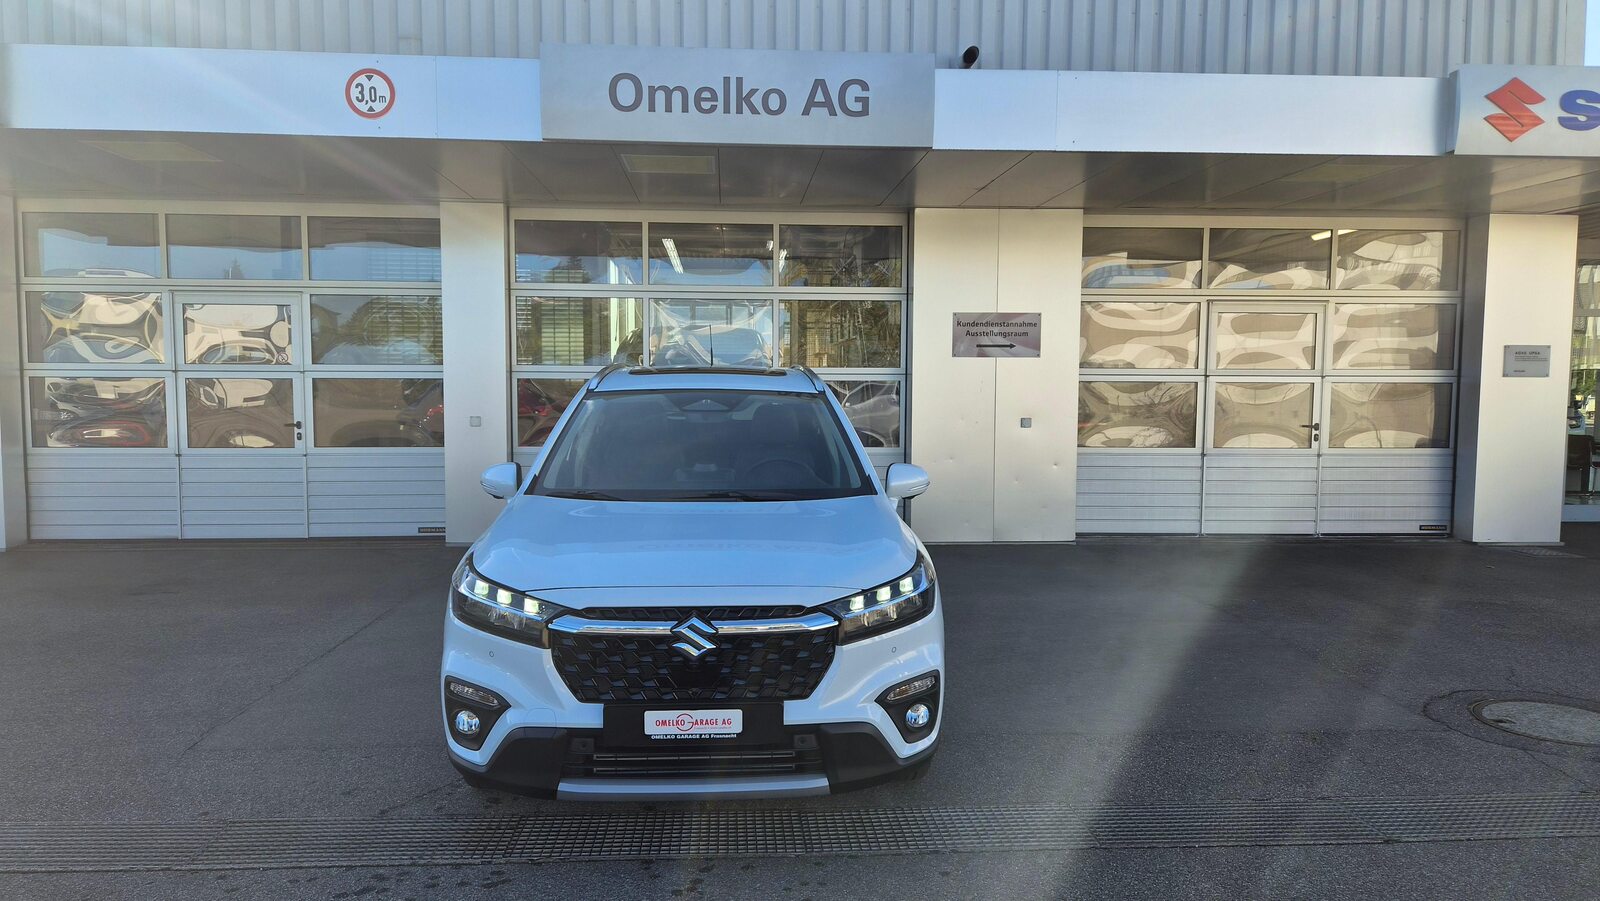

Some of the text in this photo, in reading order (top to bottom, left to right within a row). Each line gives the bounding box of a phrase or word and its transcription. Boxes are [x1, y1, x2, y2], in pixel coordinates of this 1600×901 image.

[608, 72, 870, 118] Omelko AG
[956, 320, 1038, 328] Kundendienstannahme
[965, 330, 1029, 339] Ausstellungsraum
[655, 719, 686, 727] OMELKO
[677, 713, 719, 731] GARAGE
[721, 718, 732, 726] AG
